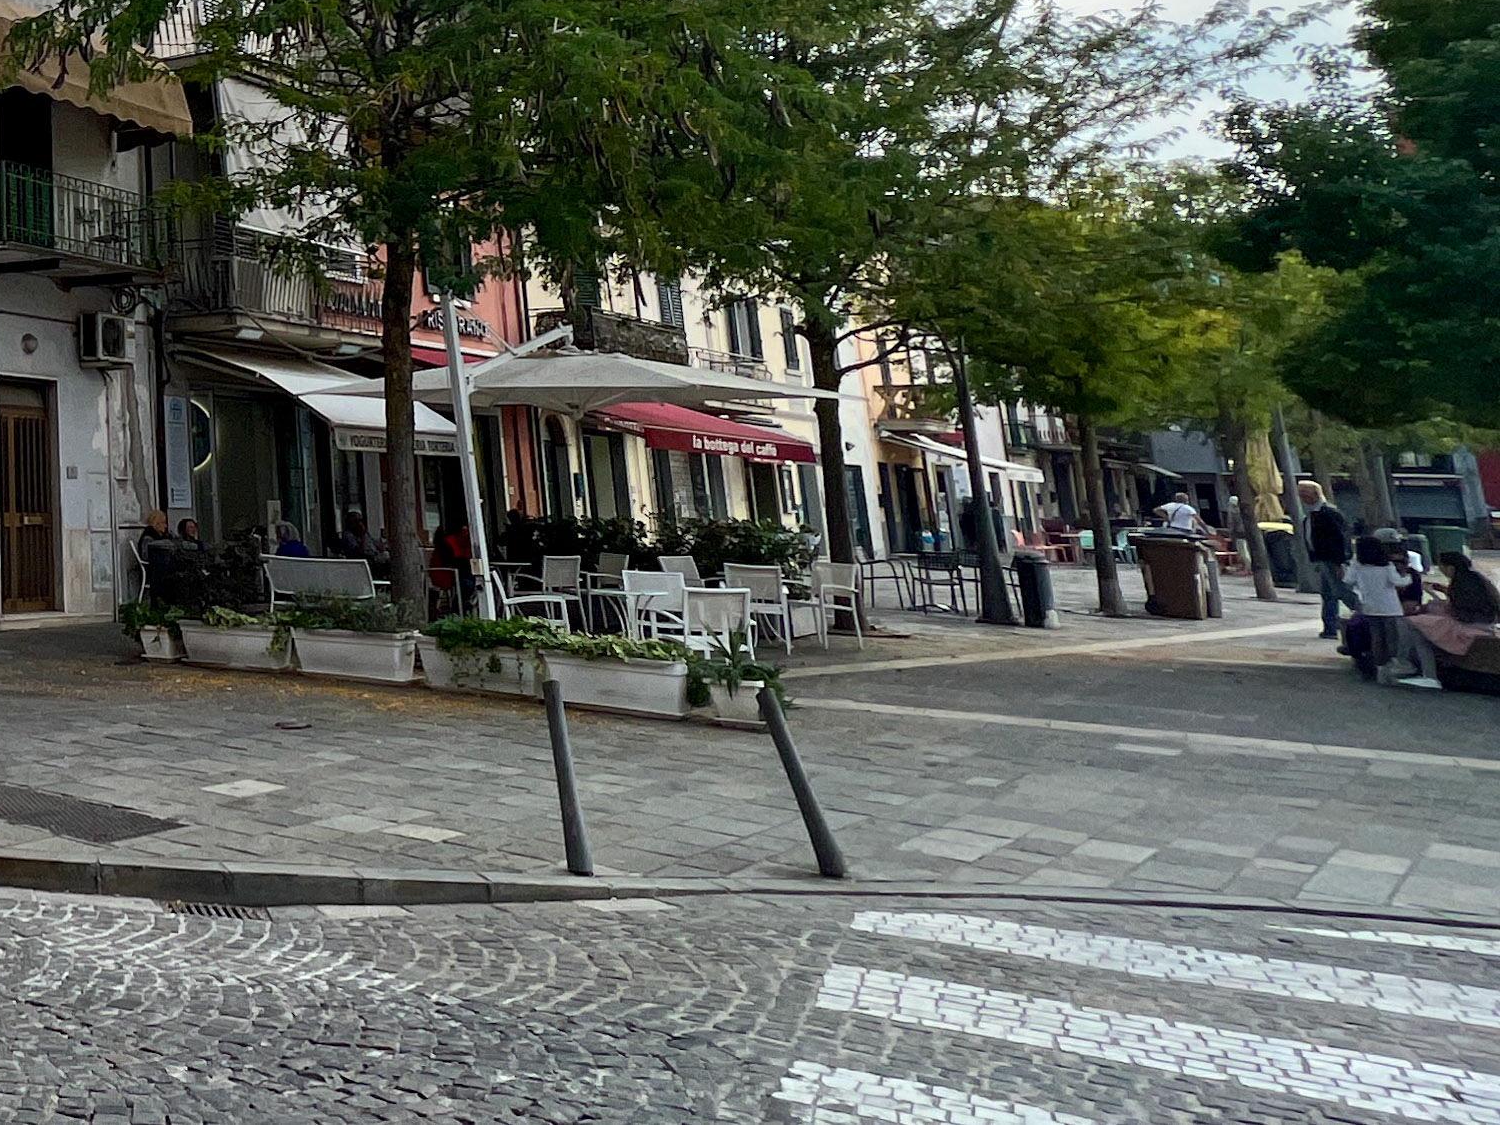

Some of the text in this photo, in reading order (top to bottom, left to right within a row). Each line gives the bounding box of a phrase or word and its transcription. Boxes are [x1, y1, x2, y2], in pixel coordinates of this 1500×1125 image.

[692, 434, 703, 450] la
[703, 436, 739, 455] bottega
[741, 441, 755, 454] del
